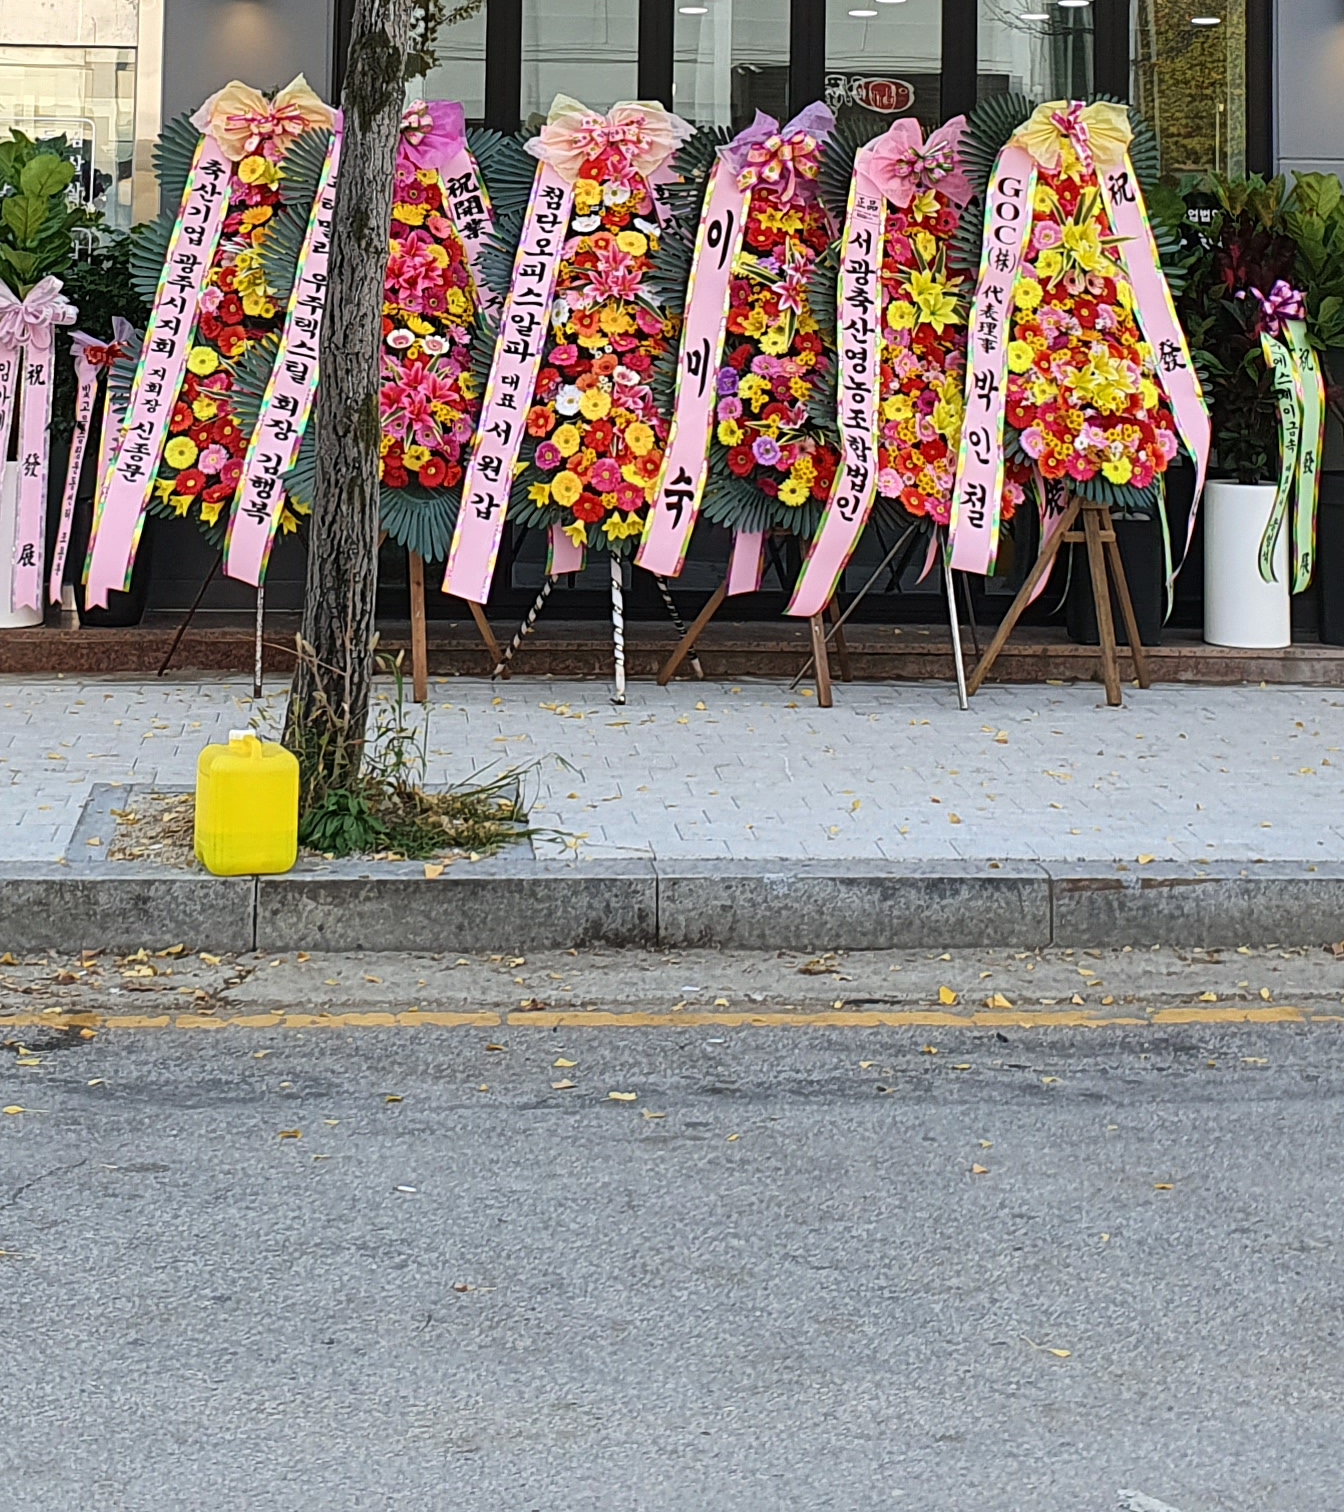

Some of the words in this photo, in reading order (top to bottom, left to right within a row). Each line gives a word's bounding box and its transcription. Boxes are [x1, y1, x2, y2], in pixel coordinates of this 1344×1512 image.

[183, 159, 227, 248] 축산기업
[445, 173, 488, 240] 祝開業
[150, 253, 203, 358] 광주시지회
[501, 184, 565, 364] 첨단오피스알파
[977, 285, 1004, 354] 代表理事
[282, 273, 327, 385] 우주텍스틸
[662, 209, 736, 530] 이미숙
[836, 229, 878, 523] 서광축산영농조합법인
[140, 366, 169, 414] 지회장
[267, 393, 300, 442] 회장
[495, 375, 522, 412] 대표
[19, 364, 47, 567] 祝發展
[116, 421, 156, 482] 신종문
[240, 452, 283, 527] 김행복
[470, 419, 514, 522] 서원갑
[959, 369, 1000, 529] 박인철
